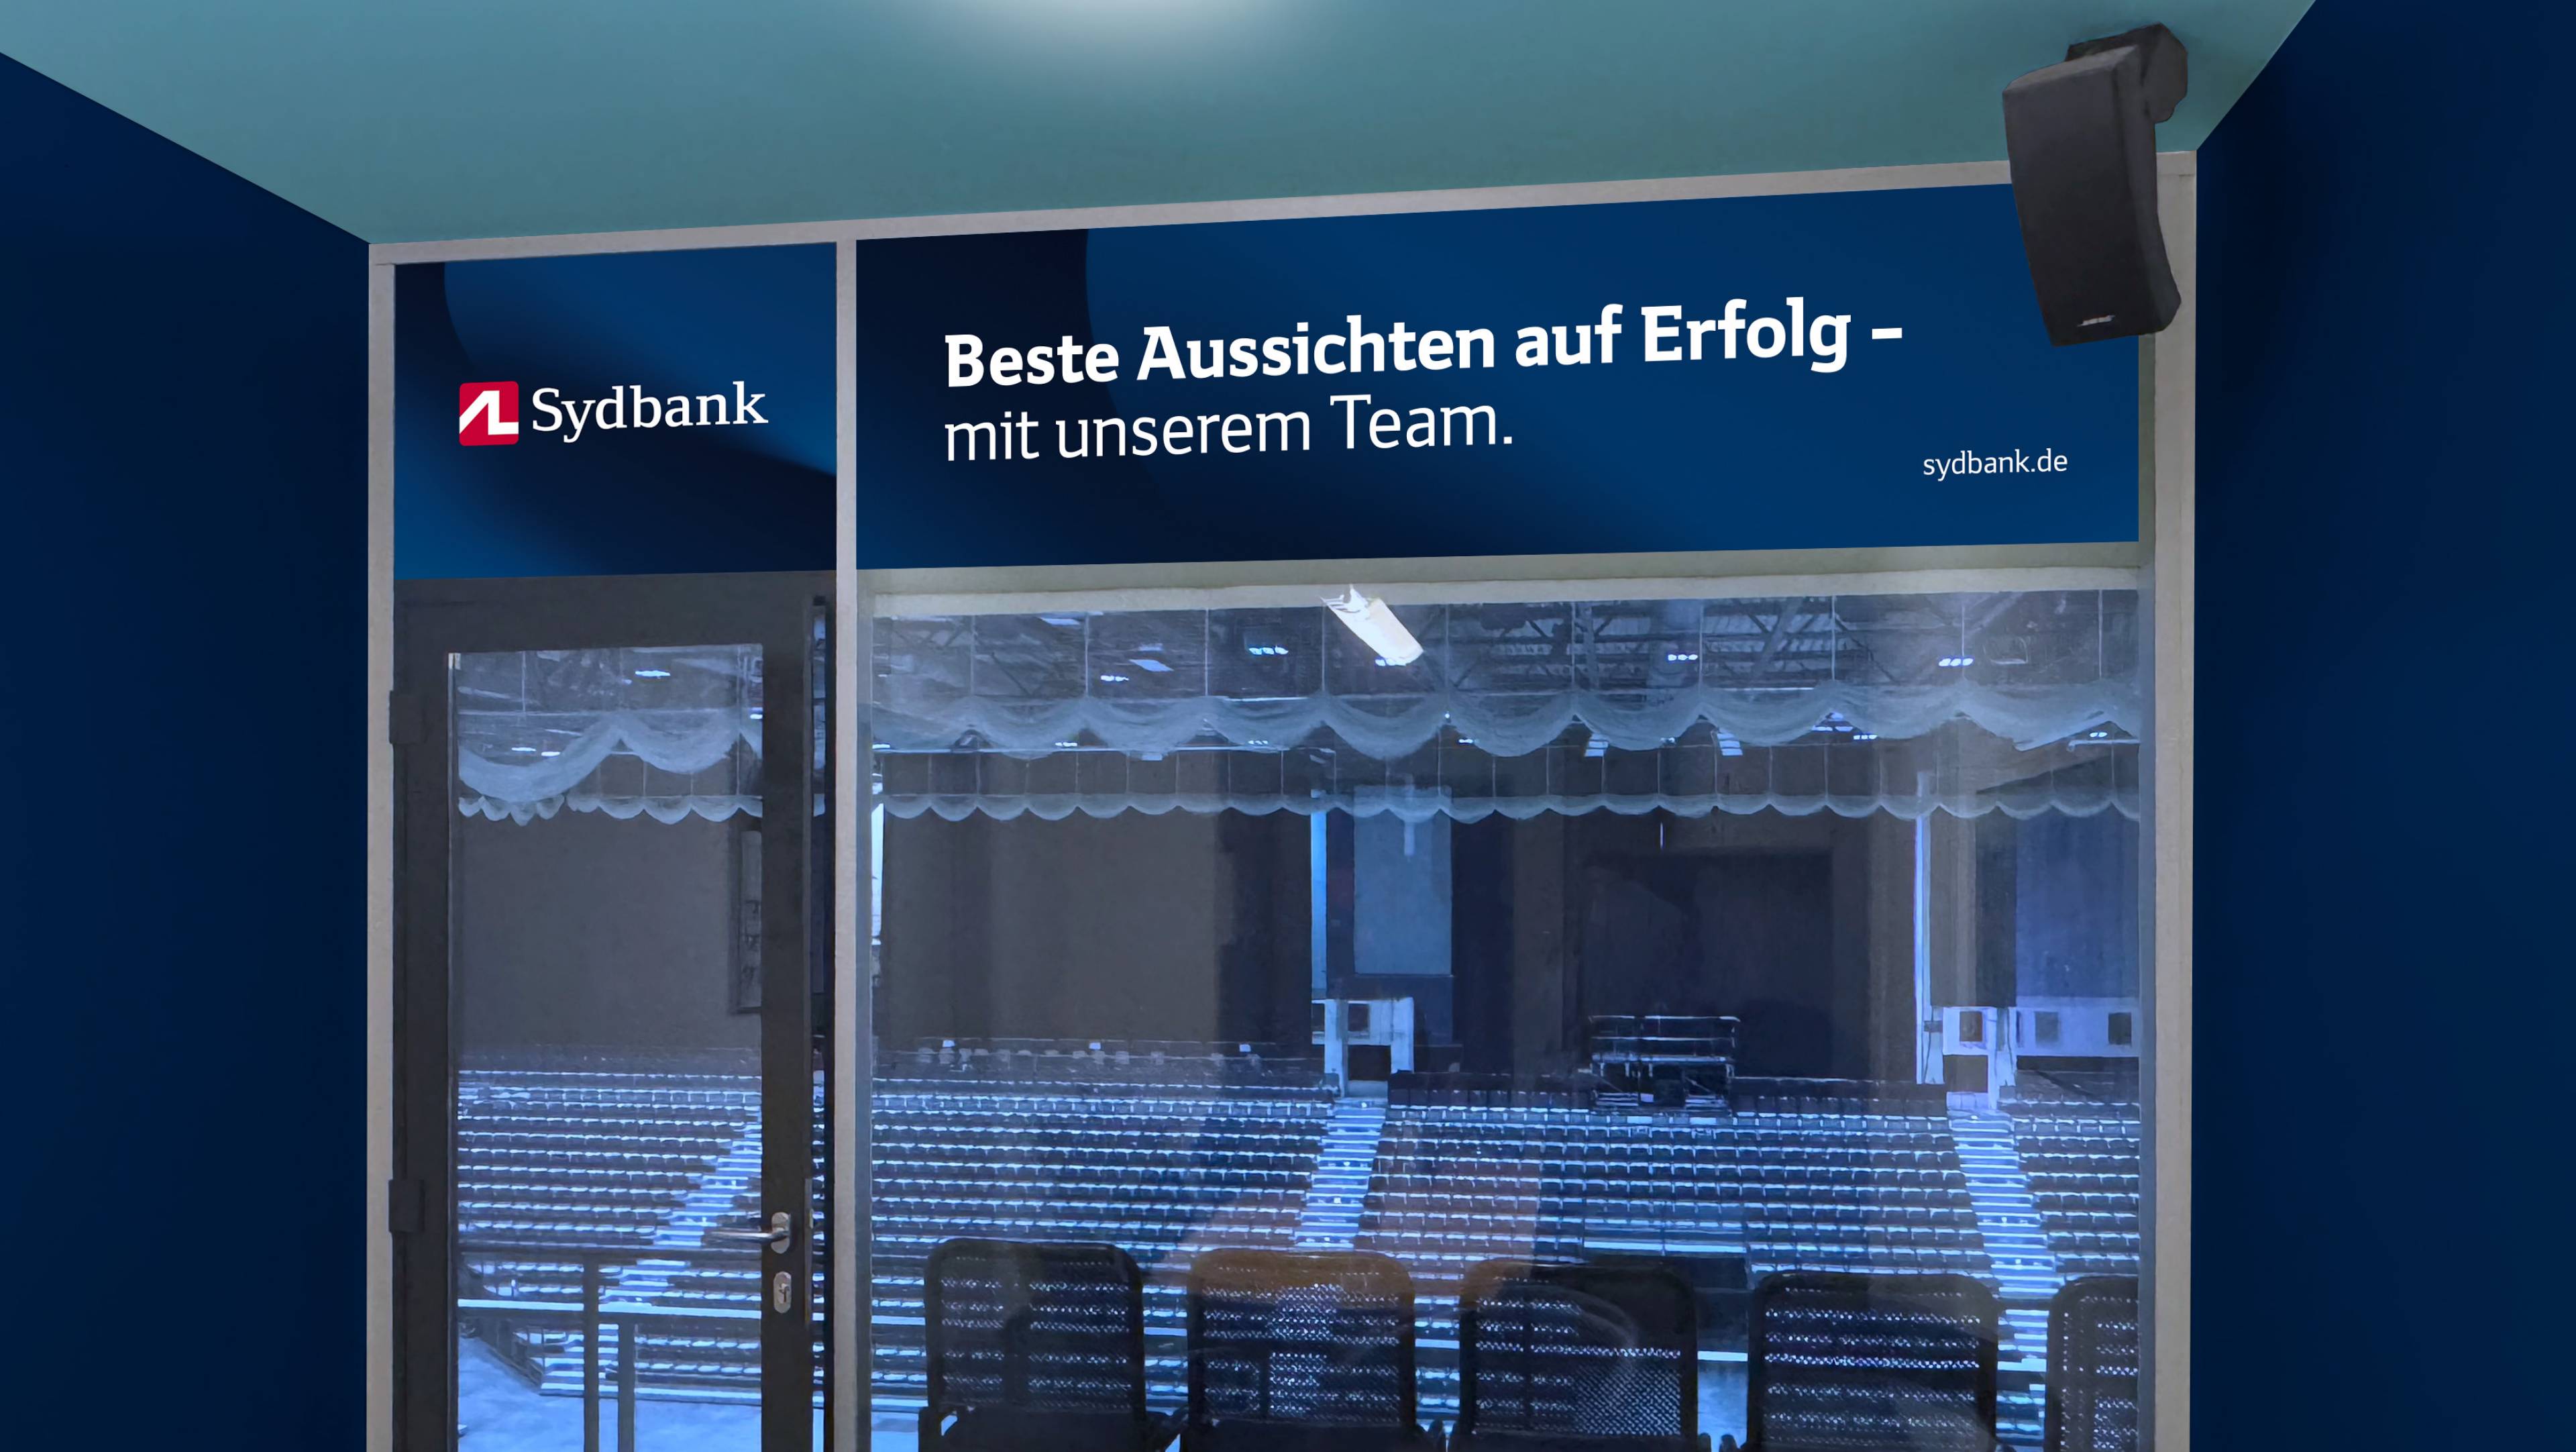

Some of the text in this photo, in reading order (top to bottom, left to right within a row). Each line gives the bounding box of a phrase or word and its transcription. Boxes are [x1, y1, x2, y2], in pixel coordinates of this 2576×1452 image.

[945, 333, 1119, 387] Beste
[1136, 314, 1495, 380] Aussichten
[1515, 303, 1623, 367] auf
[1641, 297, 1851, 373] Erfolg
[532, 380, 769, 444] Sydbank
[945, 394, 1512, 462] mit unserem Team.
[1923, 448, 2068, 482] sydbank.de
